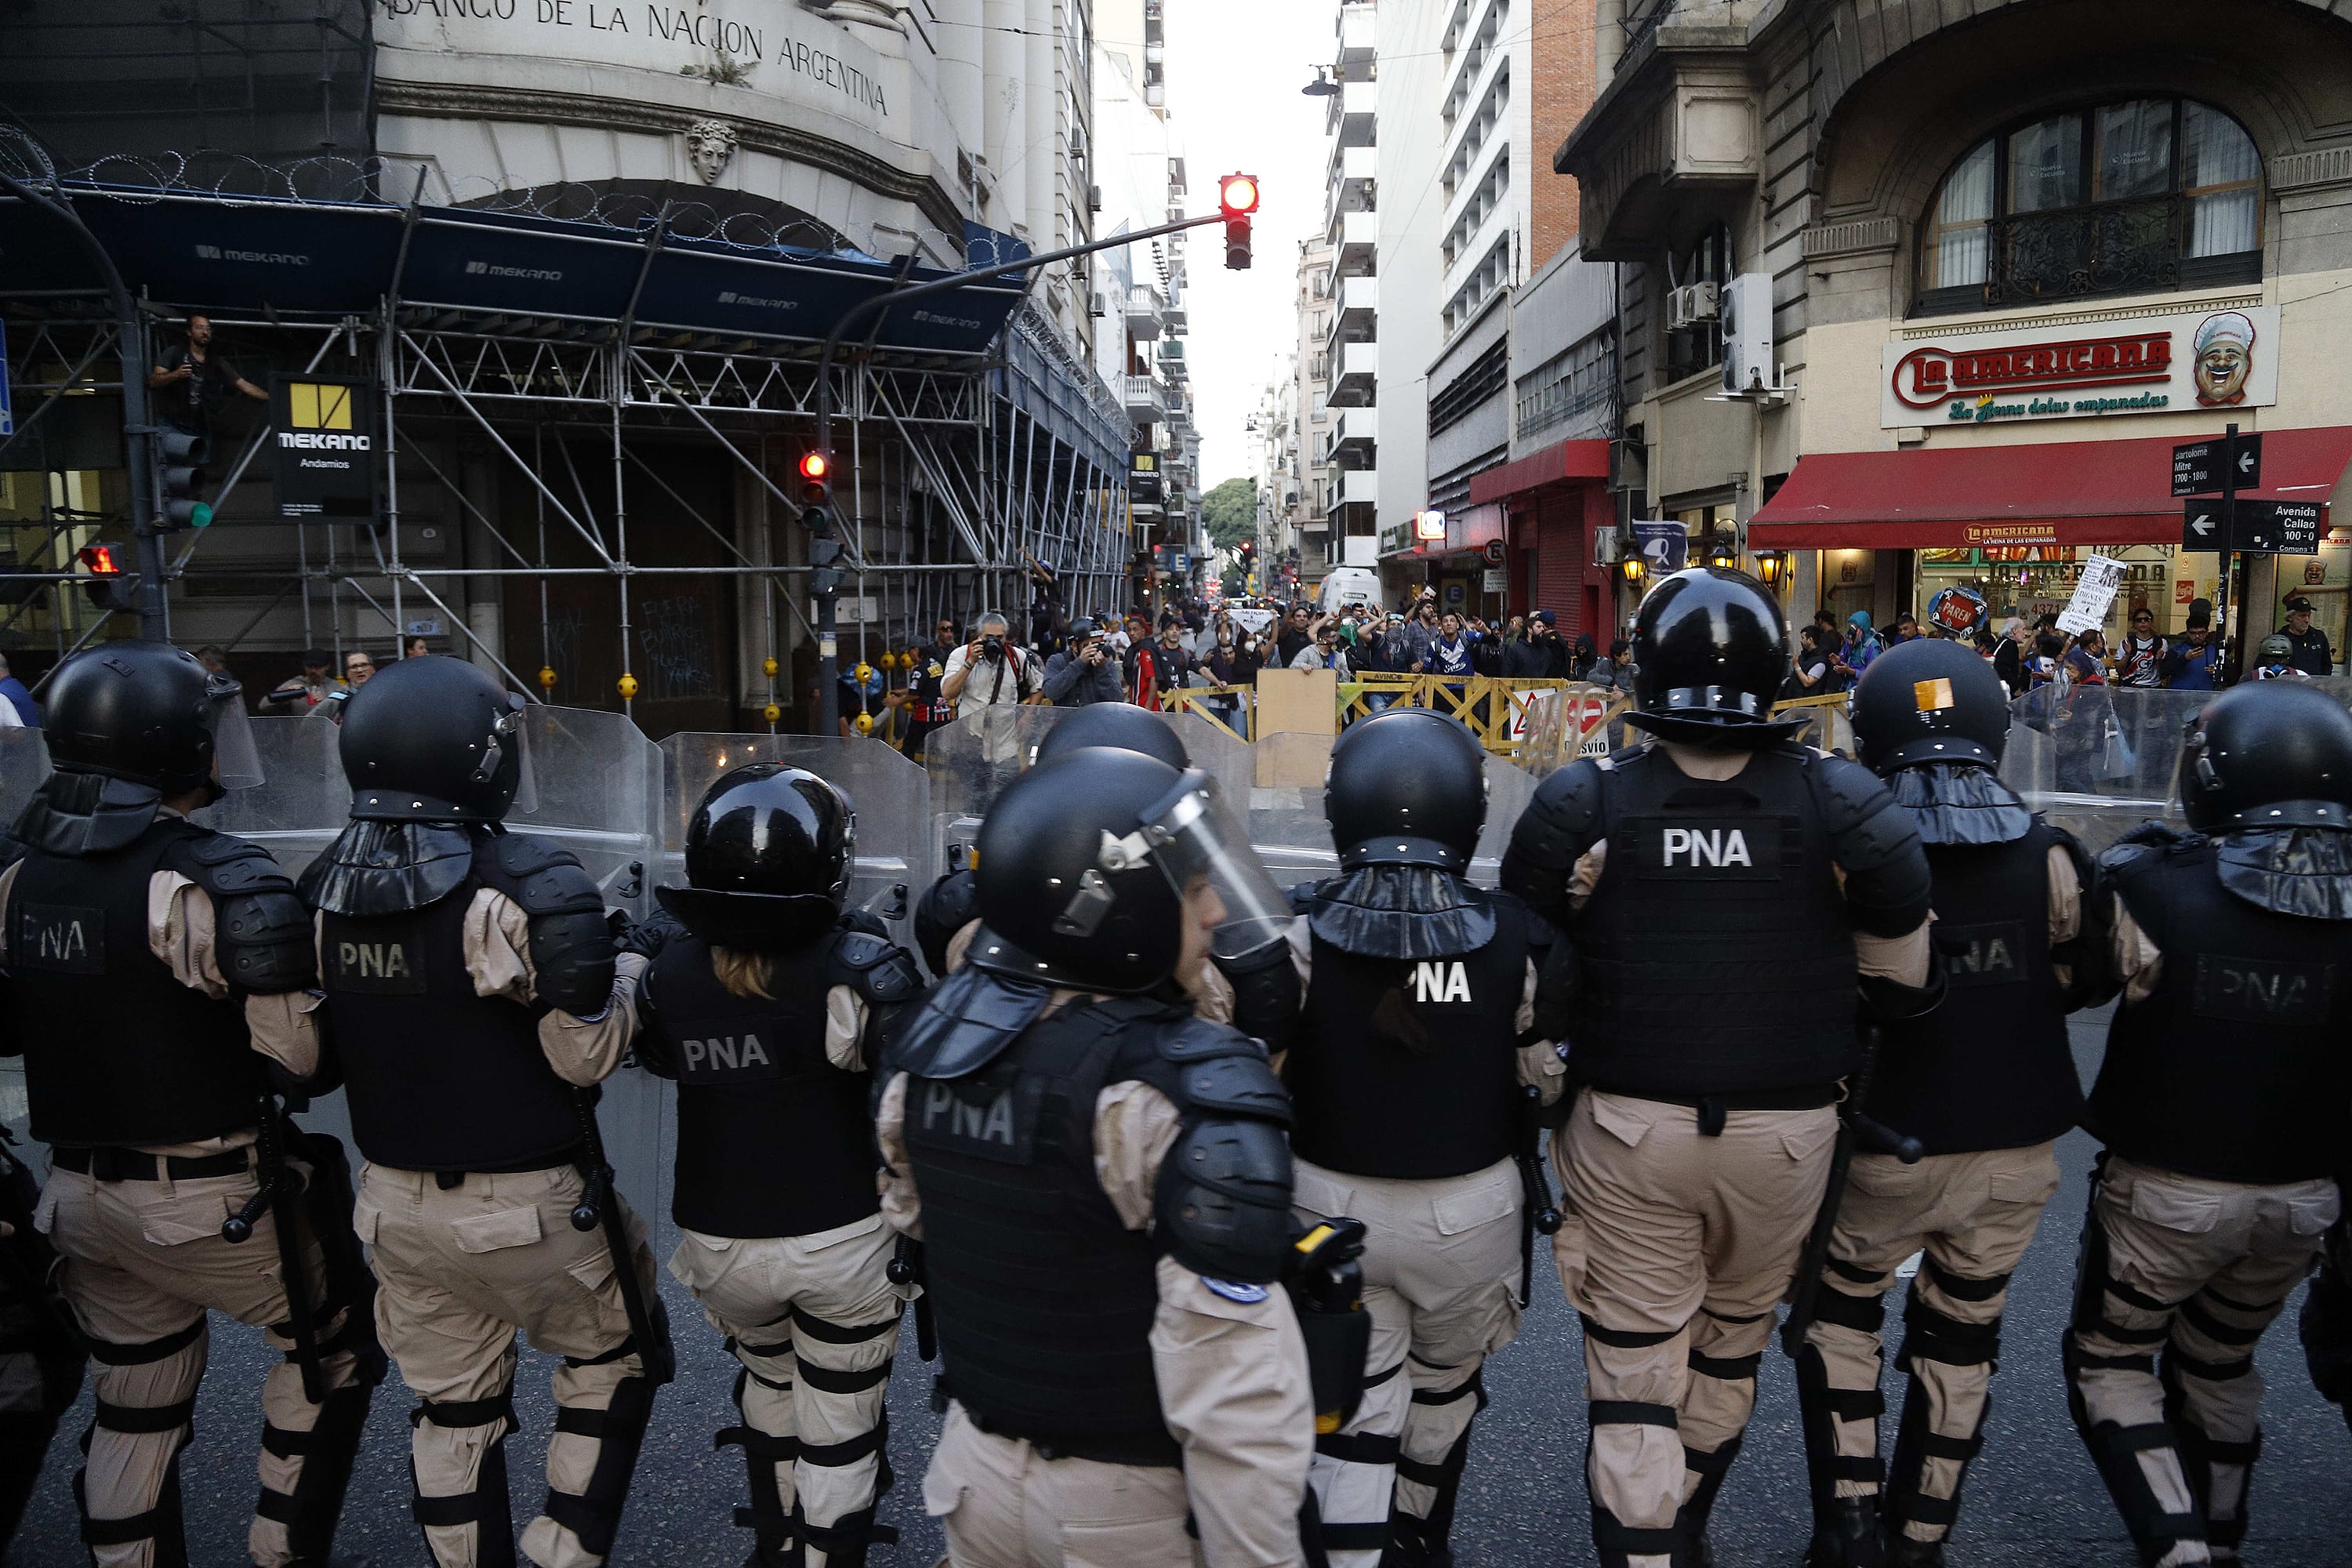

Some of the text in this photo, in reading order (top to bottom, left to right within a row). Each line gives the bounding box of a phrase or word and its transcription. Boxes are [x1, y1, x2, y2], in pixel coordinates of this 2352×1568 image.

[393, 0, 515, 20] BANCO
[538, 1, 573, 25] DE
[590, 4, 629, 33] LA
[778, 38, 887, 116] ARGENTINA
[224, 249, 310, 267] MEKANO
[489, 265, 563, 281] MEKANO
[736, 296, 798, 310] MEKANO
[1949, 401, 1973, 419] La
[2074, 392, 2169, 415] empanadas
[278, 432, 371, 451] MEKANO
[299, 458, 350, 469] Andamios
[2174, 462, 2192, 472] Mitre
[2275, 506, 2316, 517] Avenida
[2284, 518, 2315, 529] Callao
[1175, 554, 1186, 572] E
[1450, 586, 1460, 600] E
[1943, 601, 1972, 623] PAREN
[1663, 829, 1753, 867] PNA
[339, 942, 410, 978] PNA
[1951, 938, 2014, 974] NA
[1404, 961, 1472, 1003] NA
[682, 1034, 770, 1071] PNA
[924, 1081, 1014, 1146] PNA
